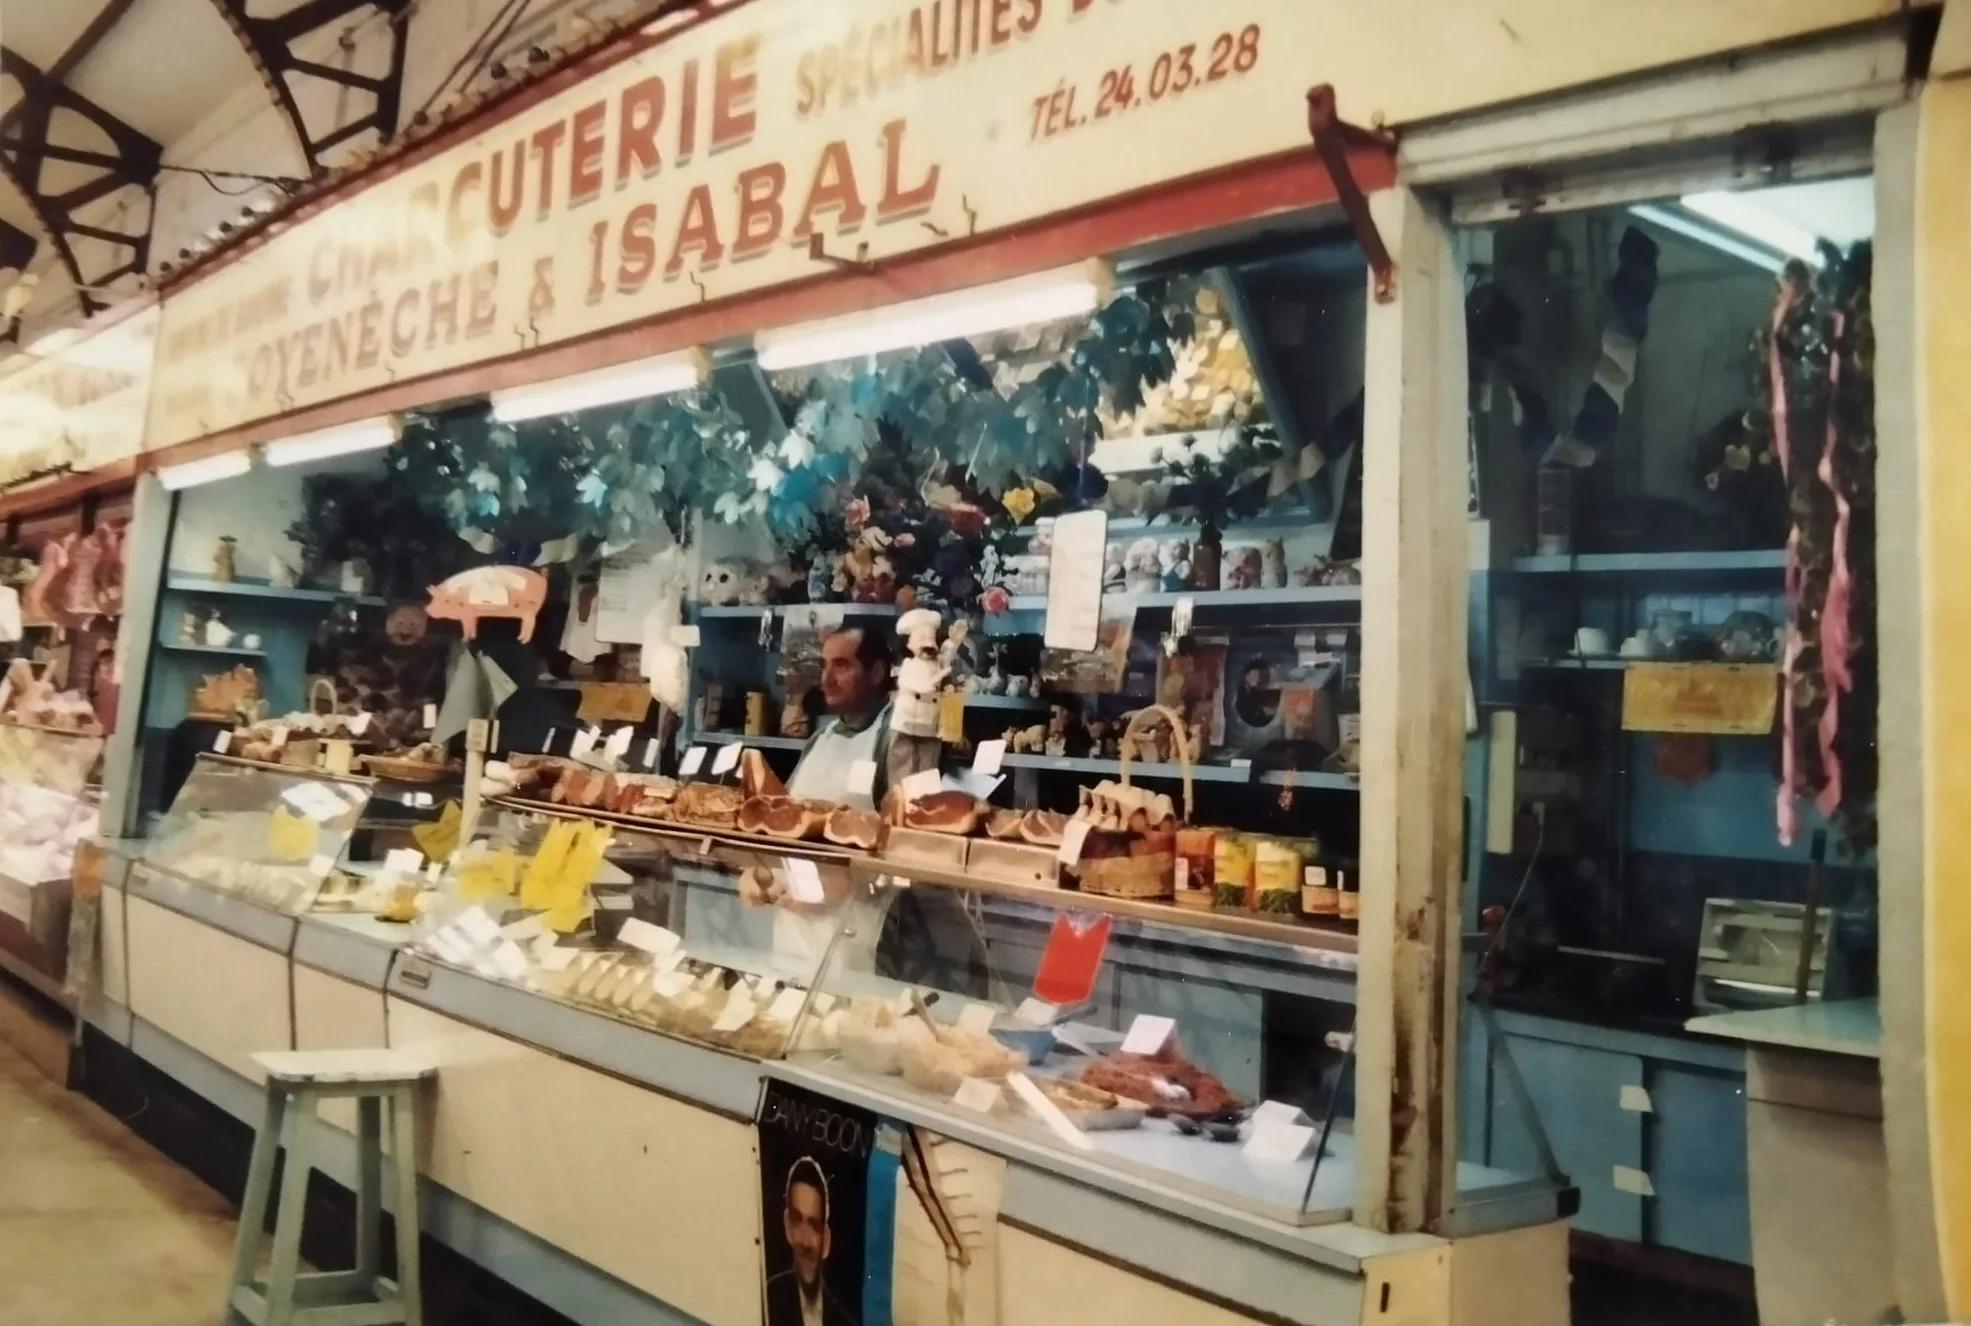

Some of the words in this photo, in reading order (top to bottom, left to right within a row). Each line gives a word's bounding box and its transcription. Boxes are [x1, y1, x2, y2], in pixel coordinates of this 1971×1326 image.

[1031, 77, 1087, 140] TÉL.
[1093, 23, 1261, 119] 24.03.28
[527, 256, 555, 322] &
[585, 118, 940, 307] ISABAL
